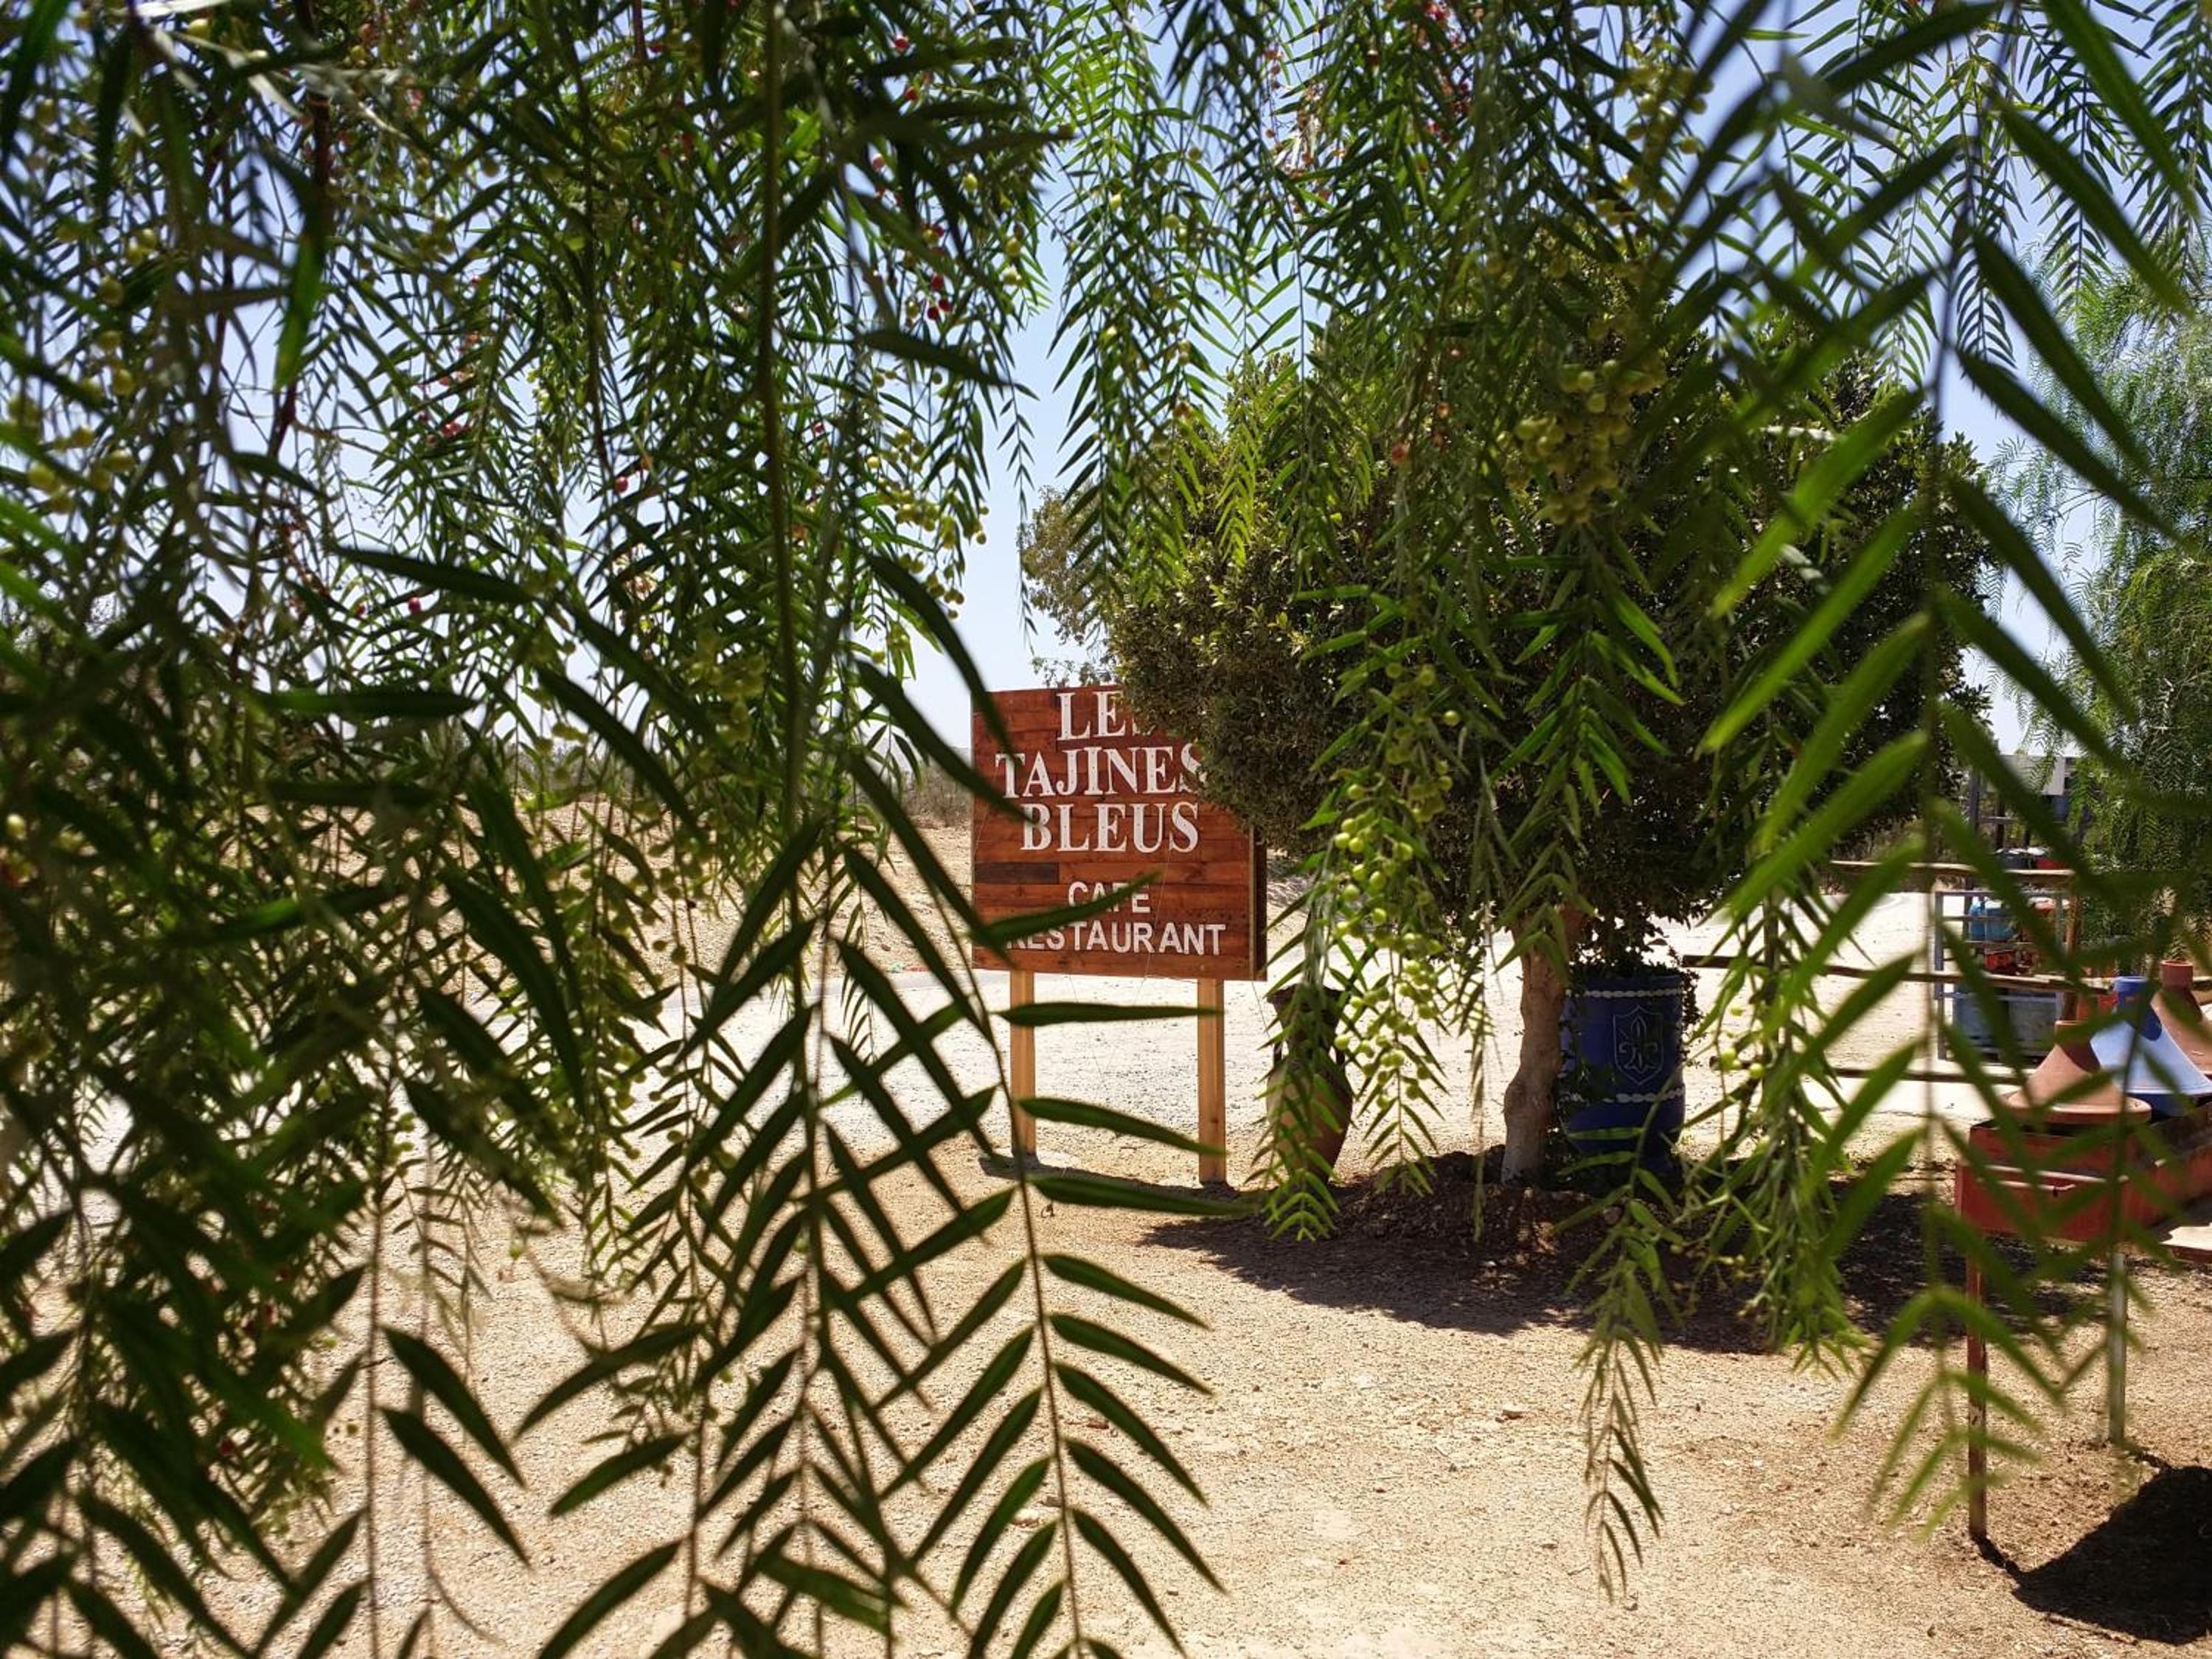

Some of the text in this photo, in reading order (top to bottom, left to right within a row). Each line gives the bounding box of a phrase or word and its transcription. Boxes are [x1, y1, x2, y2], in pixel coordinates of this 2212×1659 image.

[1057, 691, 1156, 740] LE
[995, 743, 1207, 799] TAJINES
[1020, 802, 1199, 852] BLEUS
